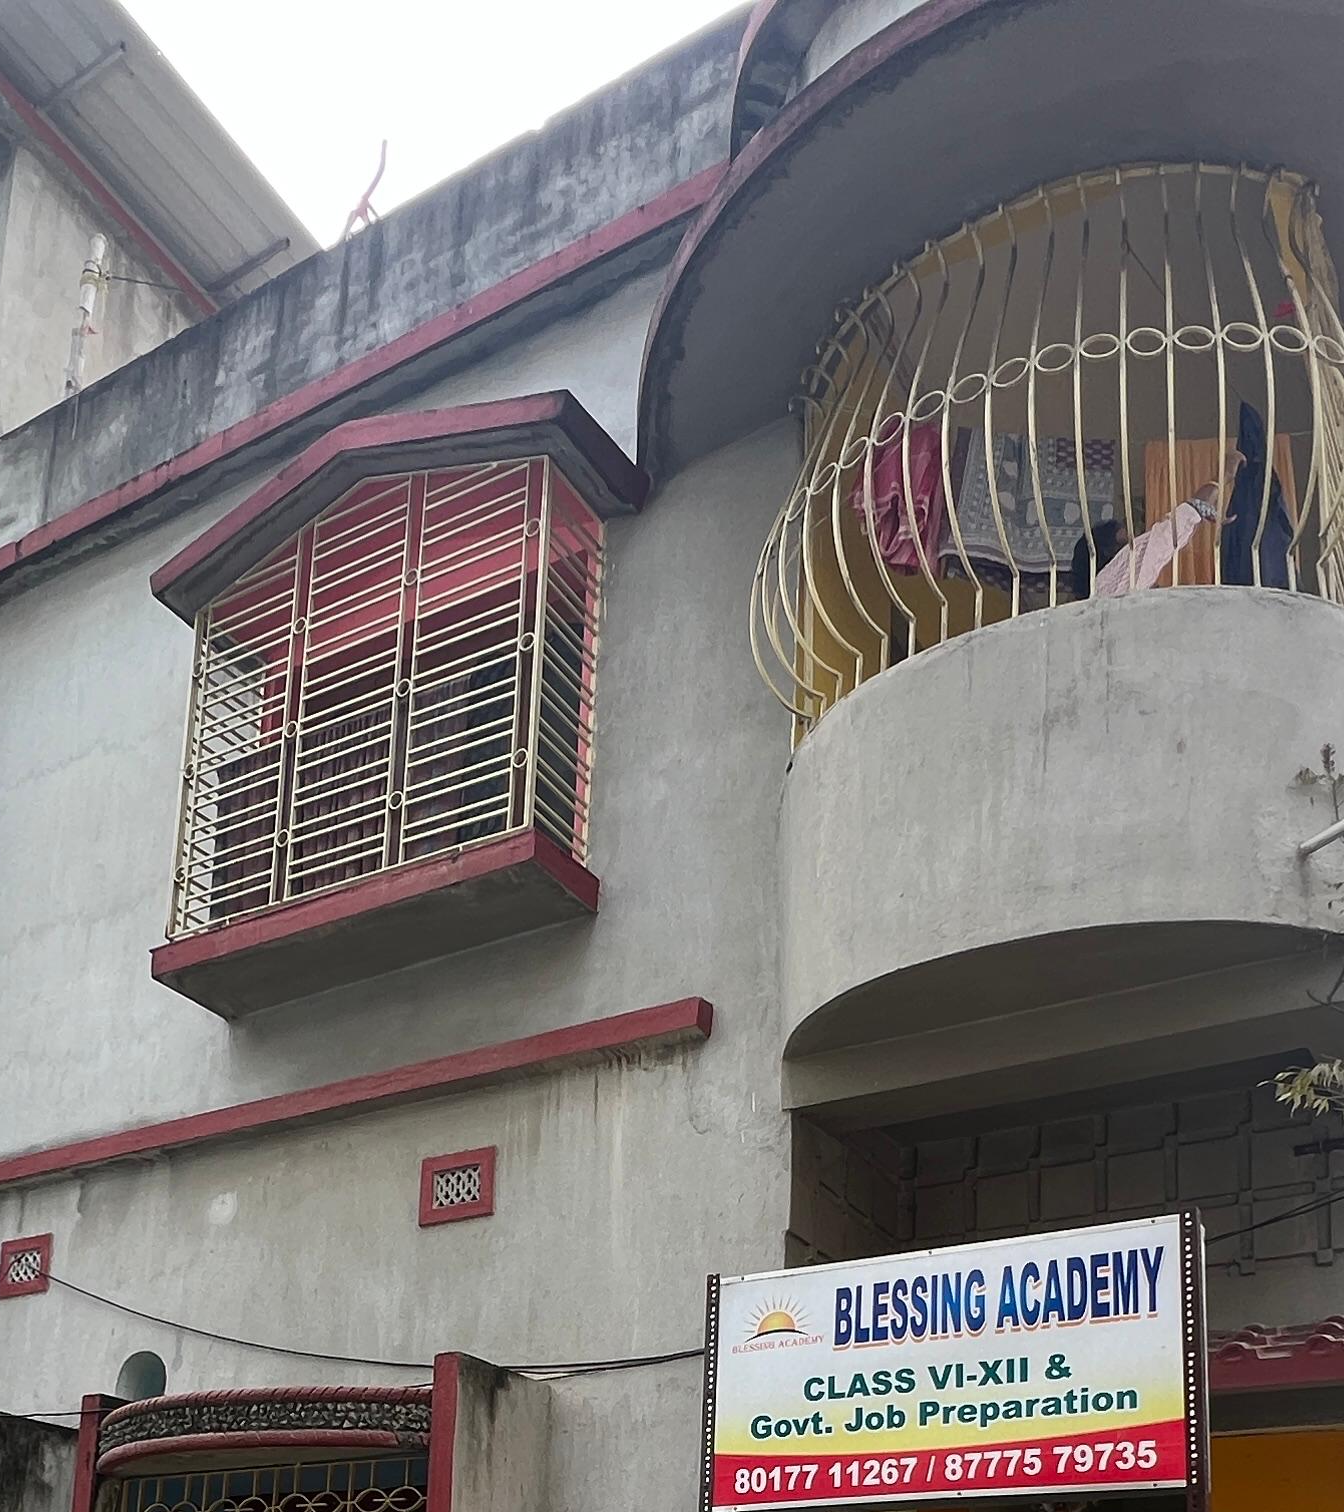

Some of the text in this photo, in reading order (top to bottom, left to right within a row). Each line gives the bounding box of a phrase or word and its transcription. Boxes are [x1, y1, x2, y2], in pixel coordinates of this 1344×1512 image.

[833, 1246, 1165, 1350] BLESSING ACADEMY
[731, 1334, 824, 1354] BLESSING ACADEMY
[803, 1352, 1073, 1402] CLASS VI-XII &
[750, 1386, 1139, 1440] Govt. Job Preparation
[734, 1439, 1158, 1495] 80177 11267 / 87775 79735
